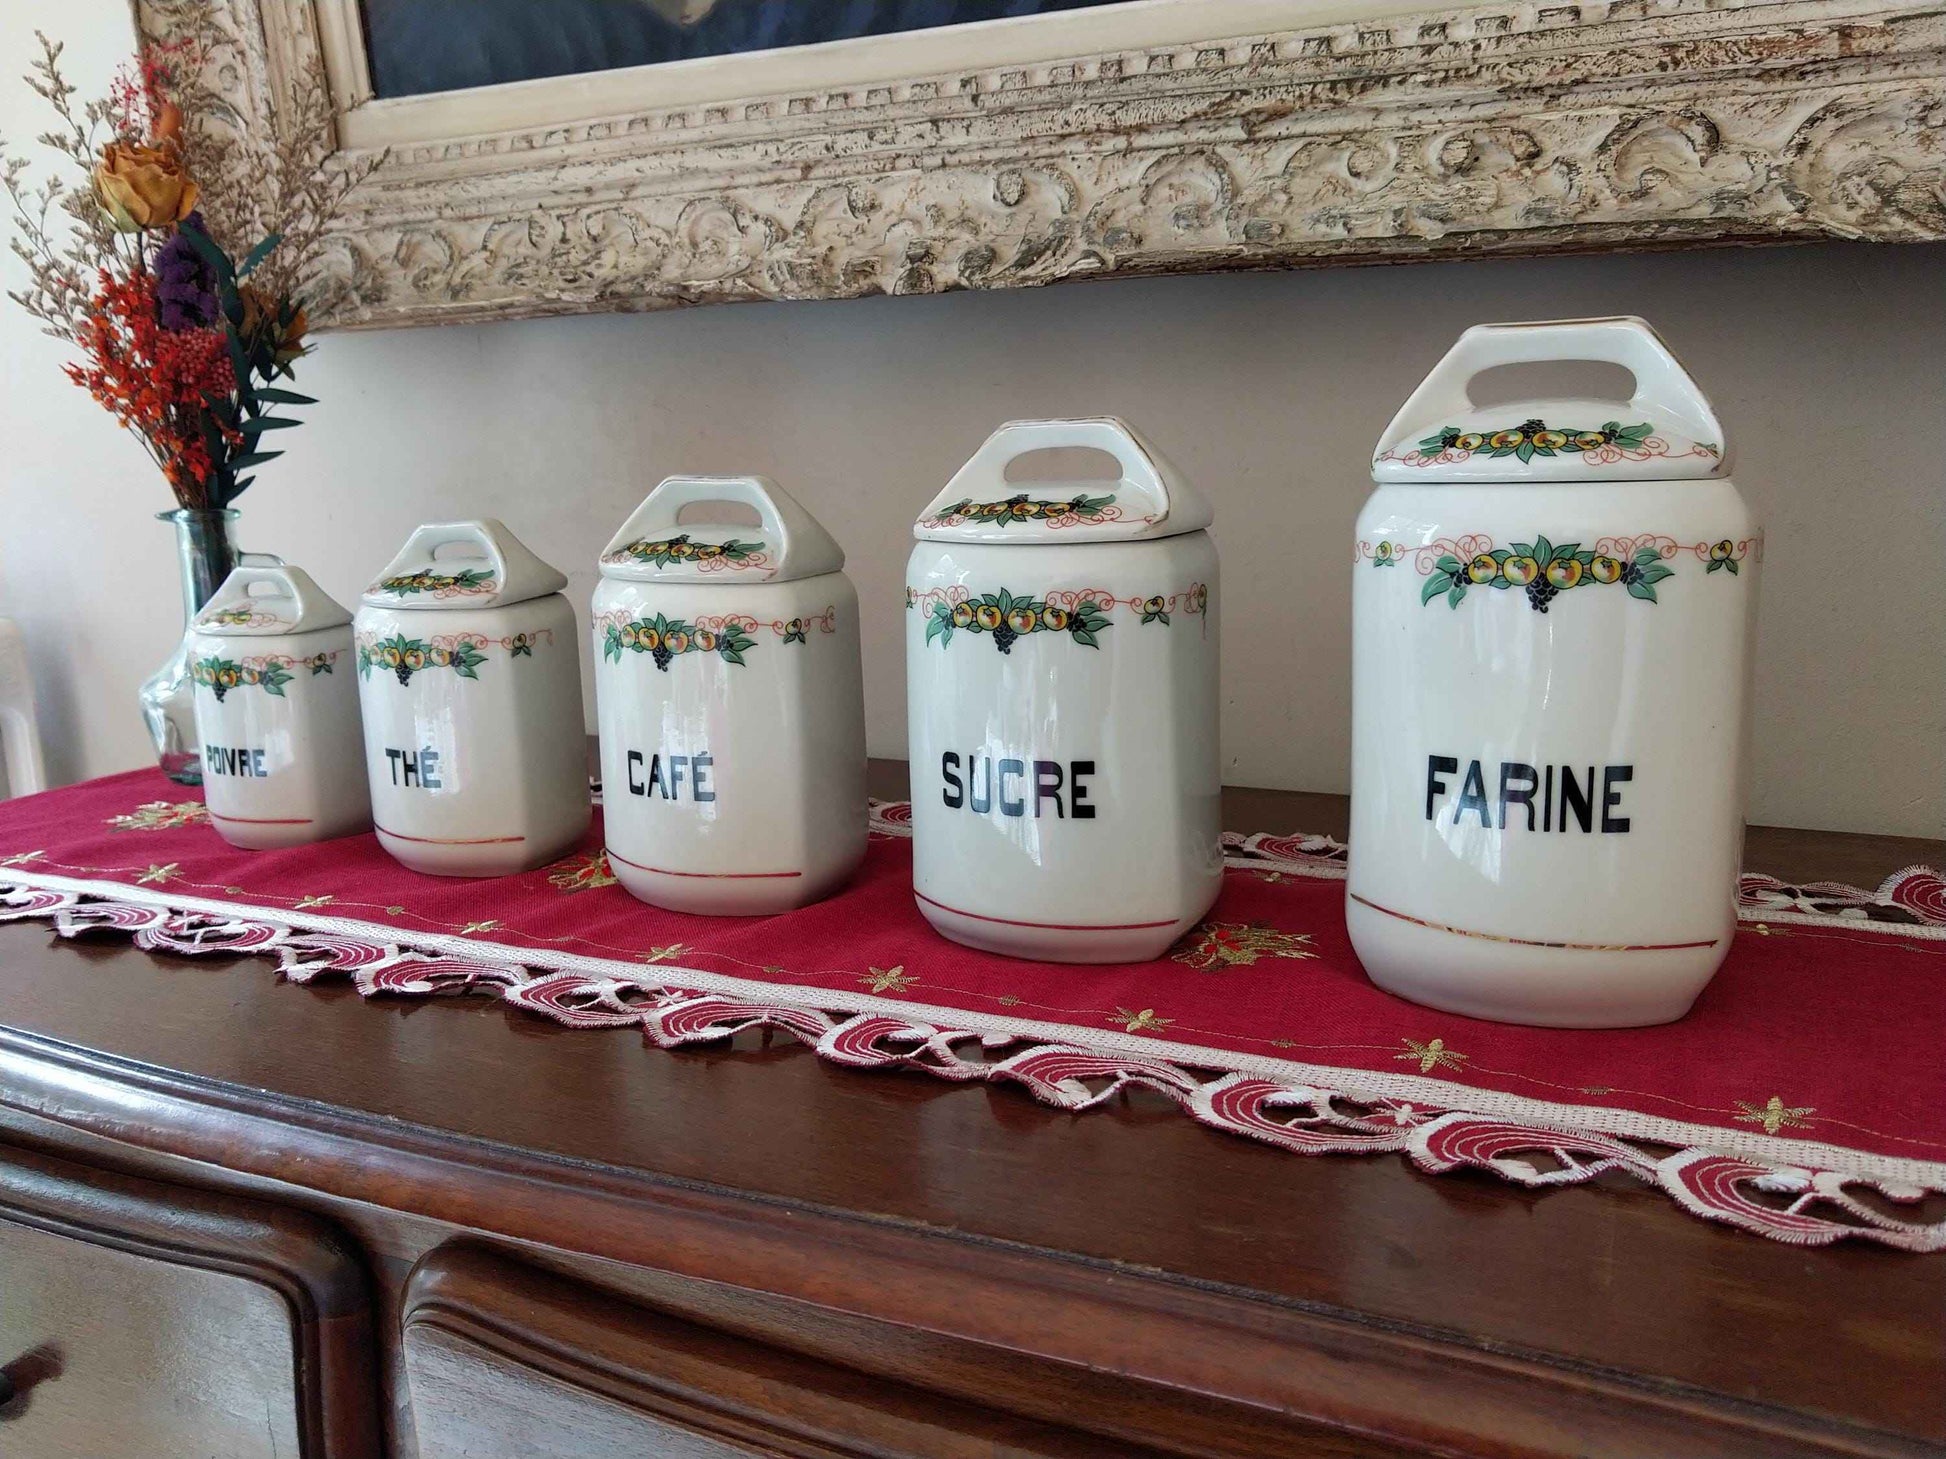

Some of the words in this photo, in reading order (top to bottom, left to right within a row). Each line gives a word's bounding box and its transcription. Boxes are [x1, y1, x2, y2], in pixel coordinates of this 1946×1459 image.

[206, 744, 267, 777] POIVRE
[385, 745, 441, 788] THÉ
[627, 750, 715, 801] CAFÉ
[942, 751, 1095, 818] SUCRE
[1426, 755, 1633, 833] FARINE
